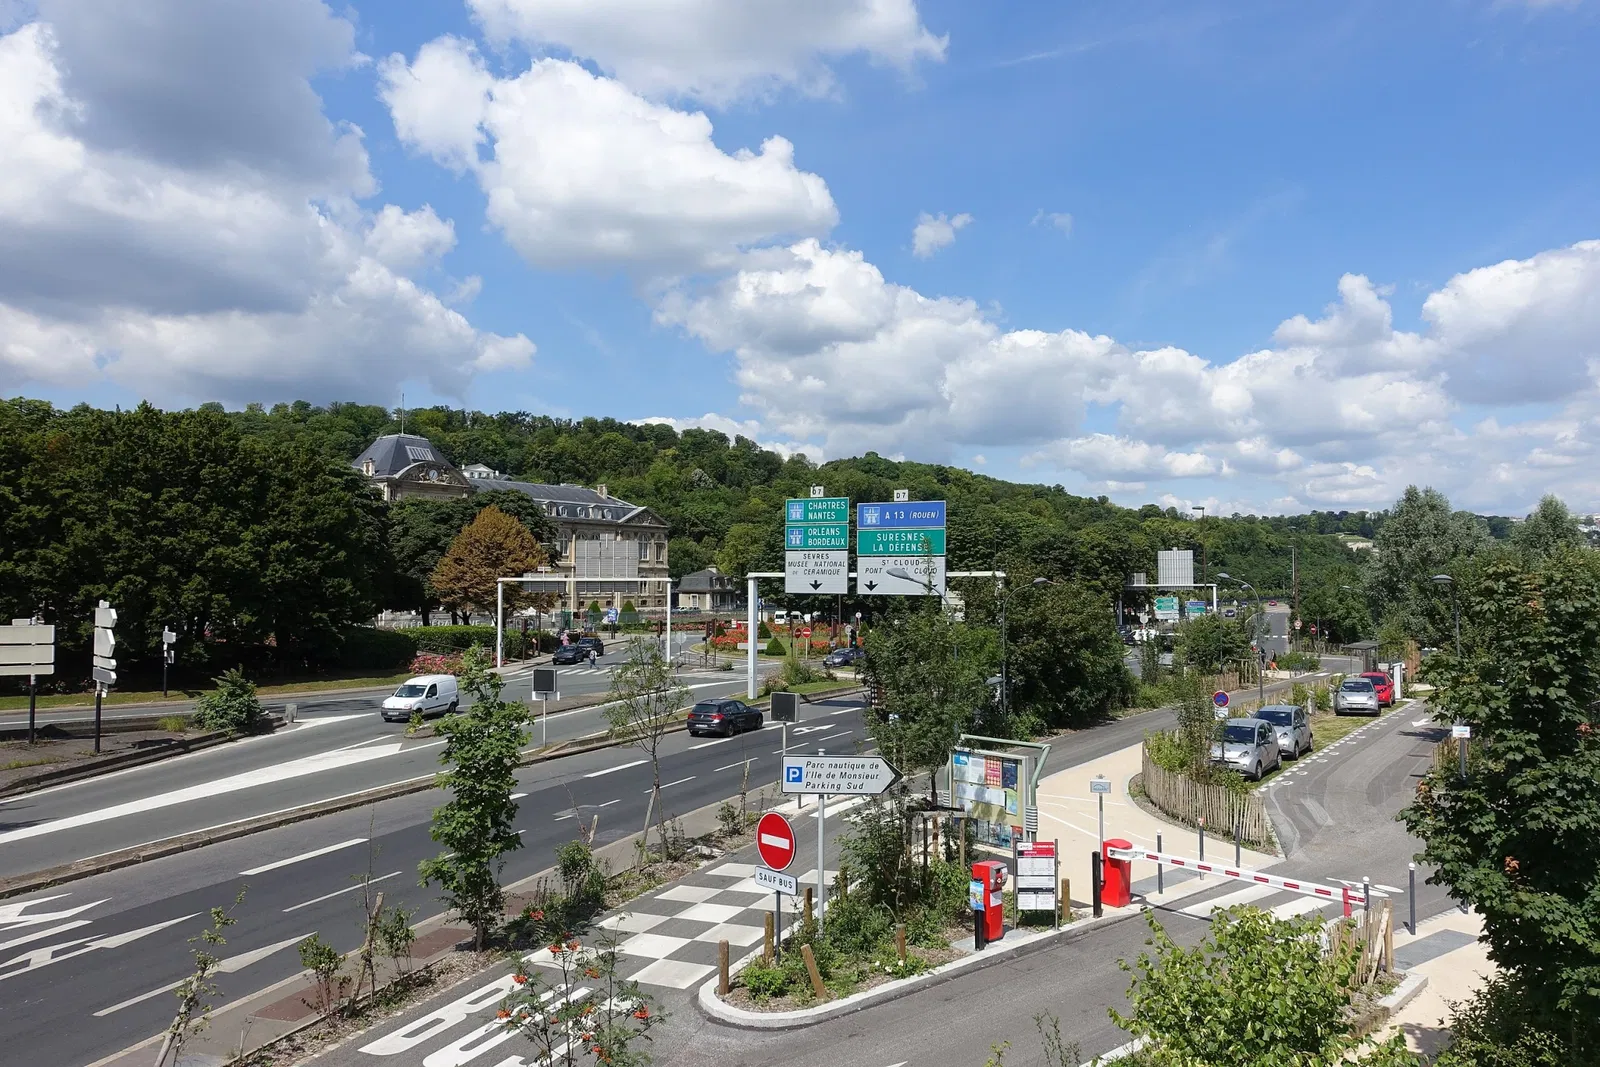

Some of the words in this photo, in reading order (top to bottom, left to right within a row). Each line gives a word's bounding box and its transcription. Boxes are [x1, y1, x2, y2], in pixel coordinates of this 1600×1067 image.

[808, 501, 846, 510] CHARTRES
[808, 511, 836, 520] NANTES
[885, 511, 890, 520] A
[894, 511, 905, 519] 13
[909, 510, 940, 520] (ROUEN)
[808, 526, 840, 536] ORLÉANS
[808, 537, 846, 546] BORDEAUX
[876, 532, 926, 542] SURESNES
[873, 544, 884, 552] LA
[814, 560, 846, 568] NATIONAL
[805, 760, 825, 769] Parc
[828, 762, 866, 771] nautique
[789, 768, 800, 782] P
[839, 772, 880, 780] Monsieur
[805, 781, 842, 791] Parking
[846, 782, 864, 790] Sud
[758, 872, 776, 884] SAUF
[778, 878, 793, 889] BUS
